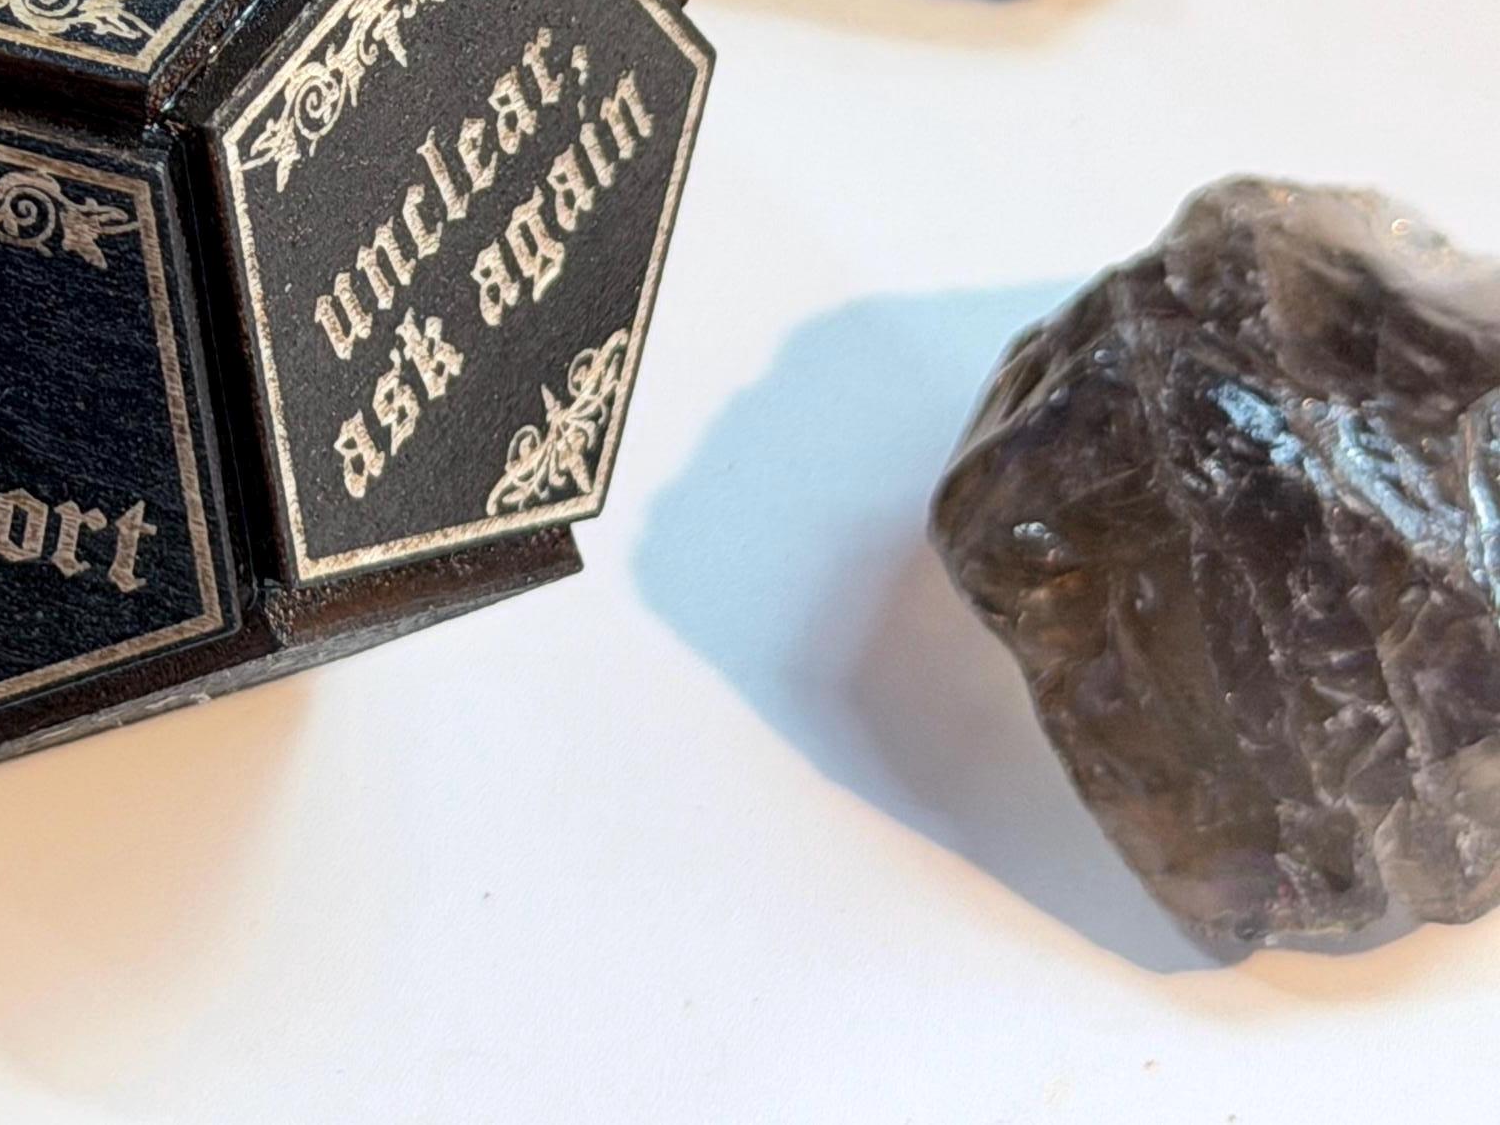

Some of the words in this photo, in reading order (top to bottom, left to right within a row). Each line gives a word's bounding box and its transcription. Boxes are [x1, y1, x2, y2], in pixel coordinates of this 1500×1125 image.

[314, 27, 590, 361] unclear,
[334, 307, 463, 499] ask
[471, 70, 656, 327] again
